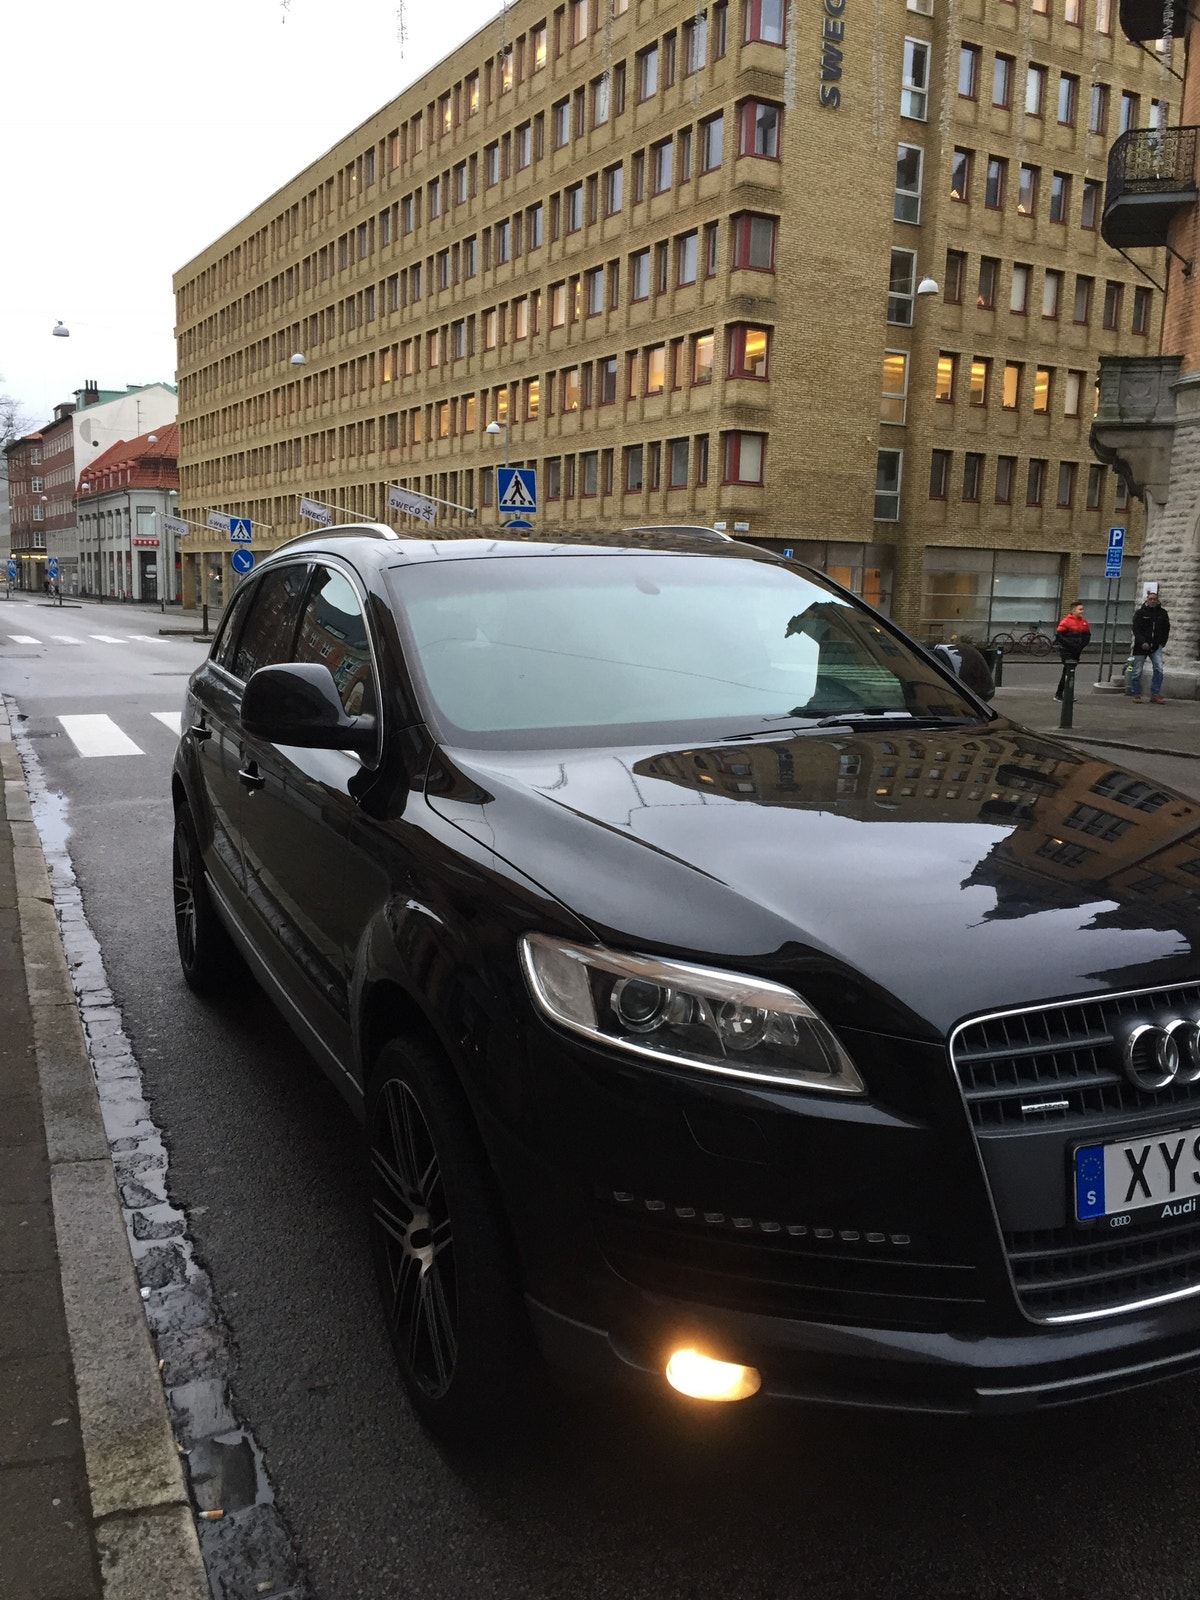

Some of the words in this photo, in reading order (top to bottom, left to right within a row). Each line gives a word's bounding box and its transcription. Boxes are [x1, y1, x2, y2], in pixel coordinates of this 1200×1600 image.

[390, 498, 421, 515] SWECO
[301, 508, 327, 522] SWECO
[164, 523, 185, 533] SWECO
[1112, 530, 1122, 546] P
[1087, 1190, 1097, 1206] S
[1161, 1198, 1197, 1218] Audi
